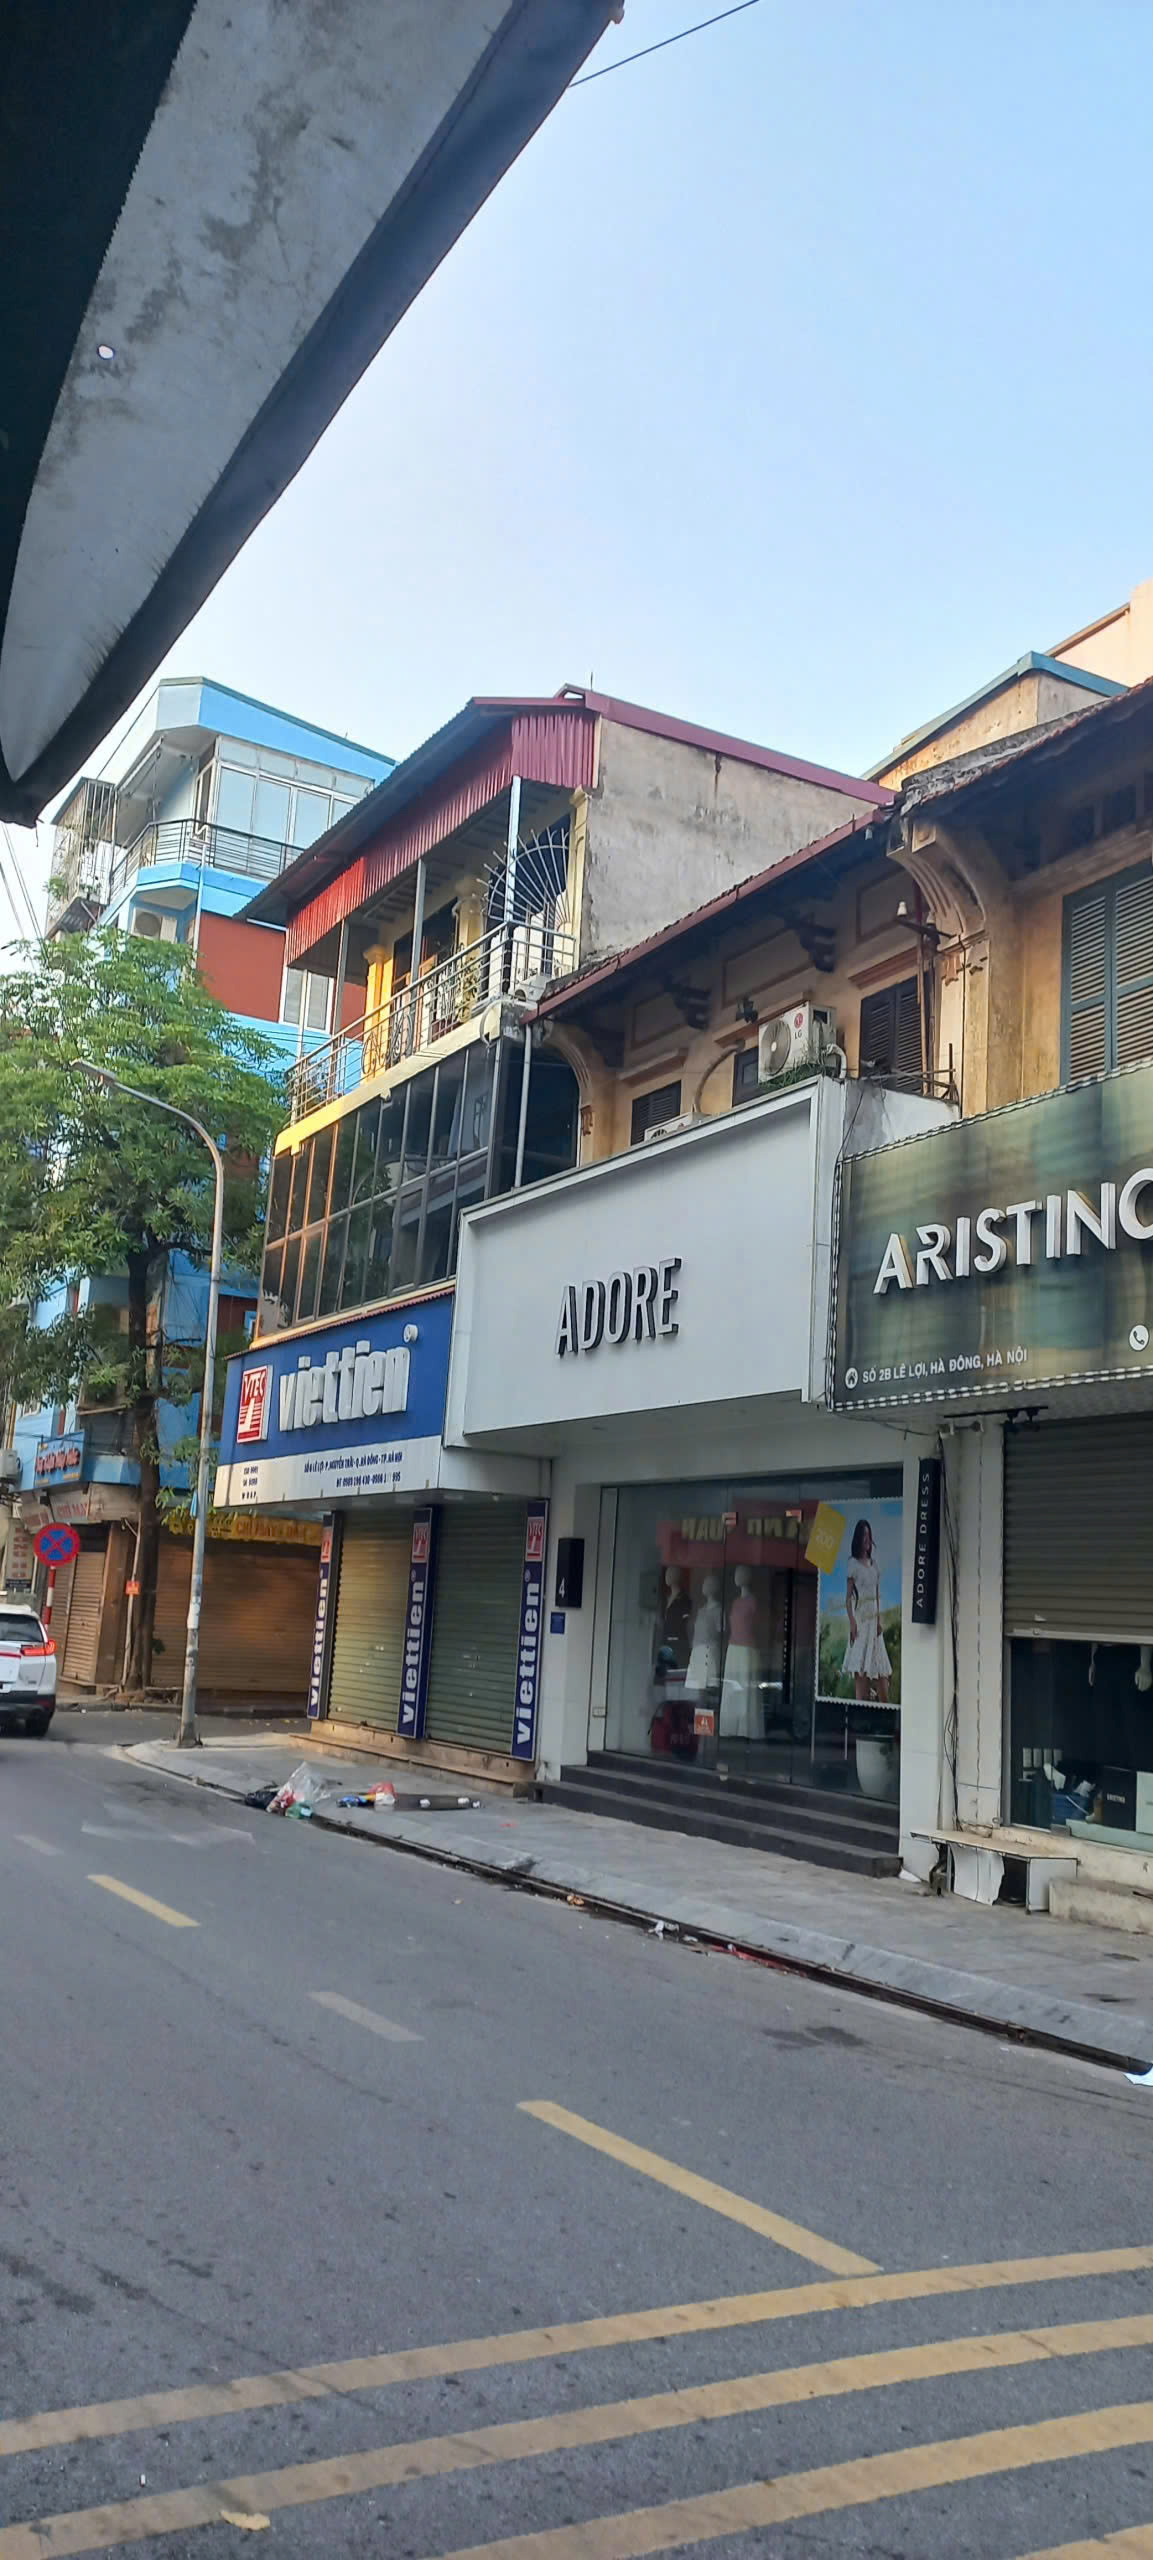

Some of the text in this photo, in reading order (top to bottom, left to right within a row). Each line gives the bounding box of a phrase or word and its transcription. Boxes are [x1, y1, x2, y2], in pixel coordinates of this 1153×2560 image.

[555, 1257, 682, 1357] ADORE
[243, 1371, 266, 1403] VTEC
[279, 1340, 411, 1432] viettien
[862, 1346, 1028, 1383] SỐ 2B LÊ LỢI, HÀ ĐÔNG, HÀ NỘI
[558, 1577, 566, 1598] 4
[915, 1473, 930, 1608] ADORE DRESS
[310, 1578, 327, 1706] viettien
[402, 1581, 424, 1724] viettien
[515, 1582, 540, 1745] viettien
